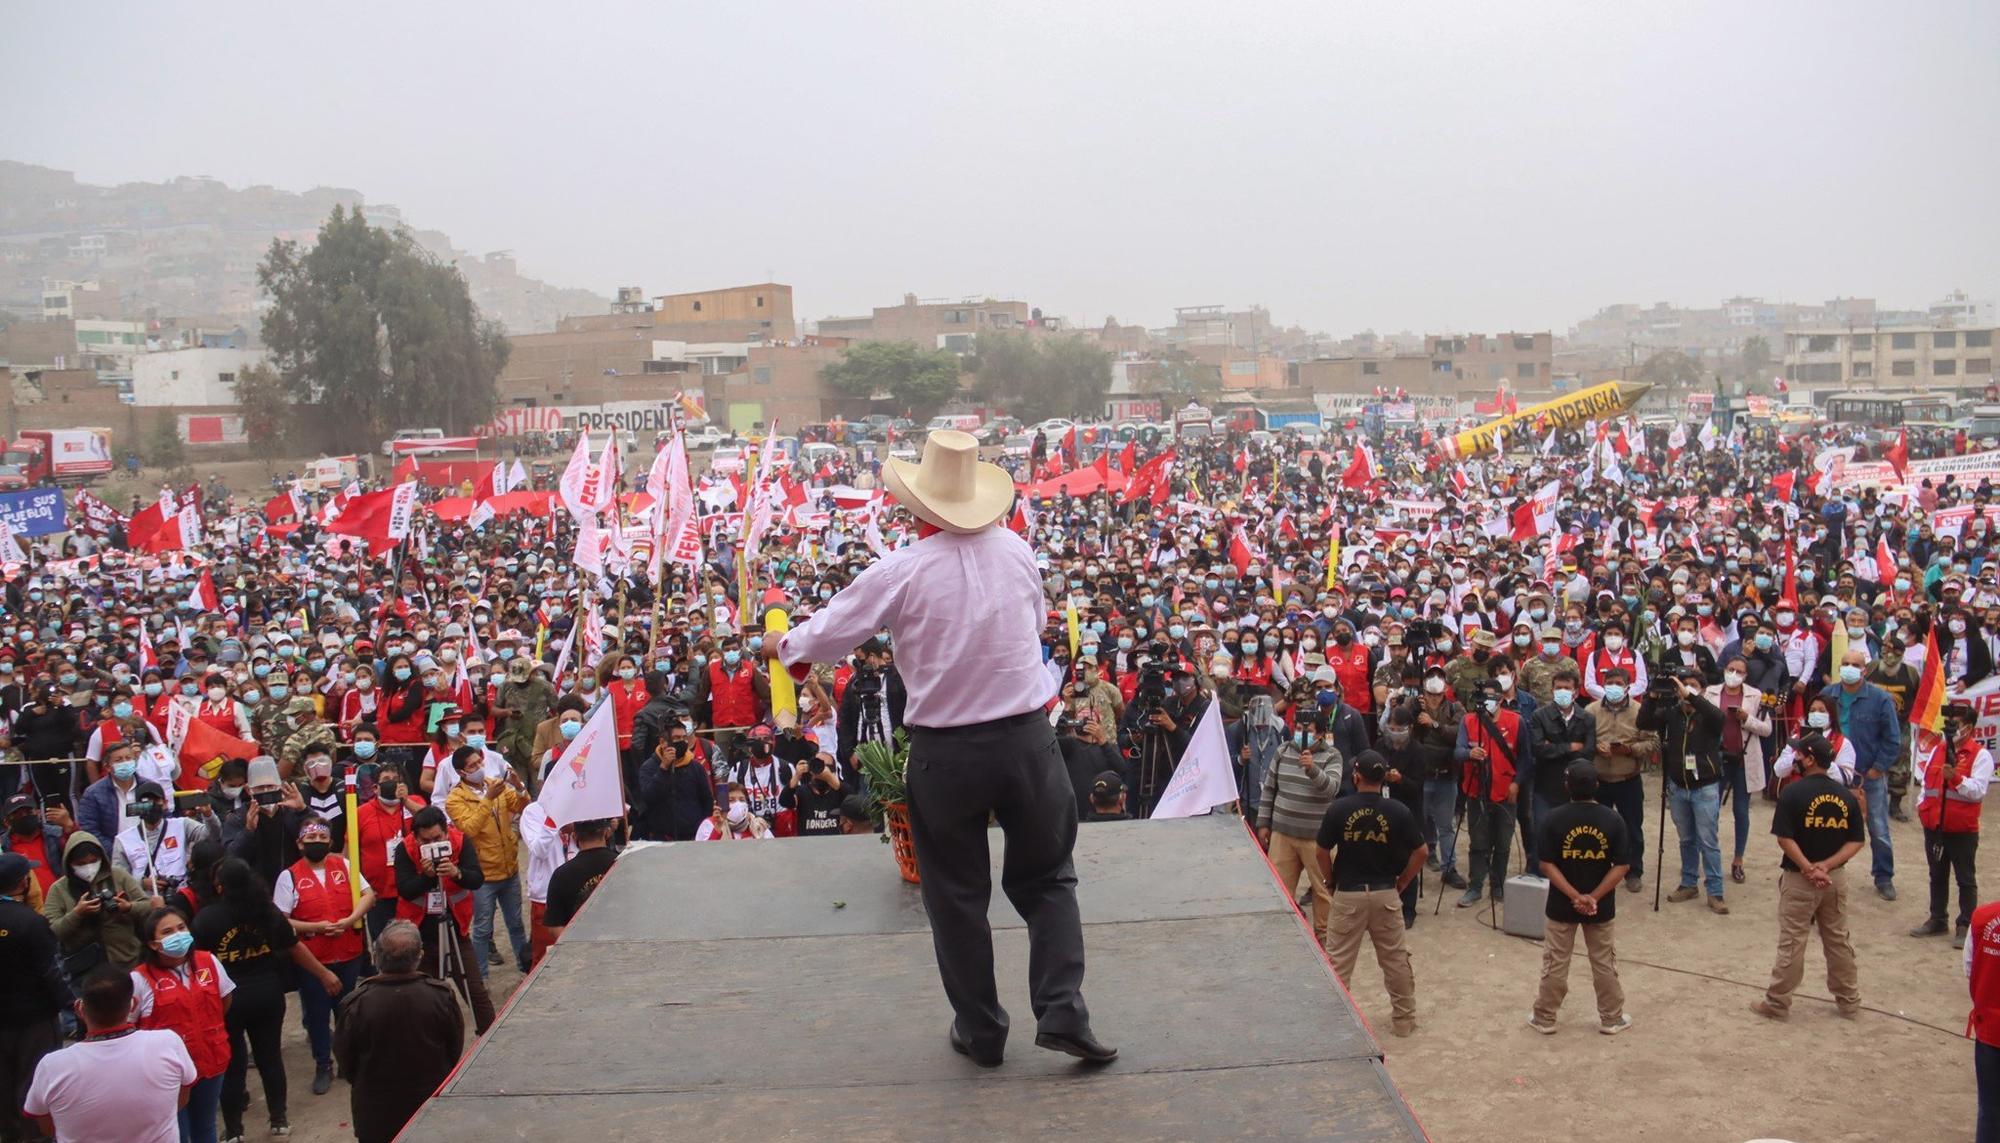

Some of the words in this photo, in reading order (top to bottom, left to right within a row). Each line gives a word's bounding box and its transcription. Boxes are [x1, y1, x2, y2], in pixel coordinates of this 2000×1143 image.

[578, 402, 684, 433] PRESIDENTE
[1471, 388, 1622, 451] INDPNDENCIA
[33, 494, 56, 507] SUS
[3, 507, 53, 522] PUEBLO!
[814, 810, 827, 819] THE
[1807, 794, 1849, 817] LICENCIADOS
[1344, 808, 1390, 832] LICENCIDOS
[1343, 831, 1387, 844] FFAA
[1562, 825, 1609, 850] LICENCIADOS
